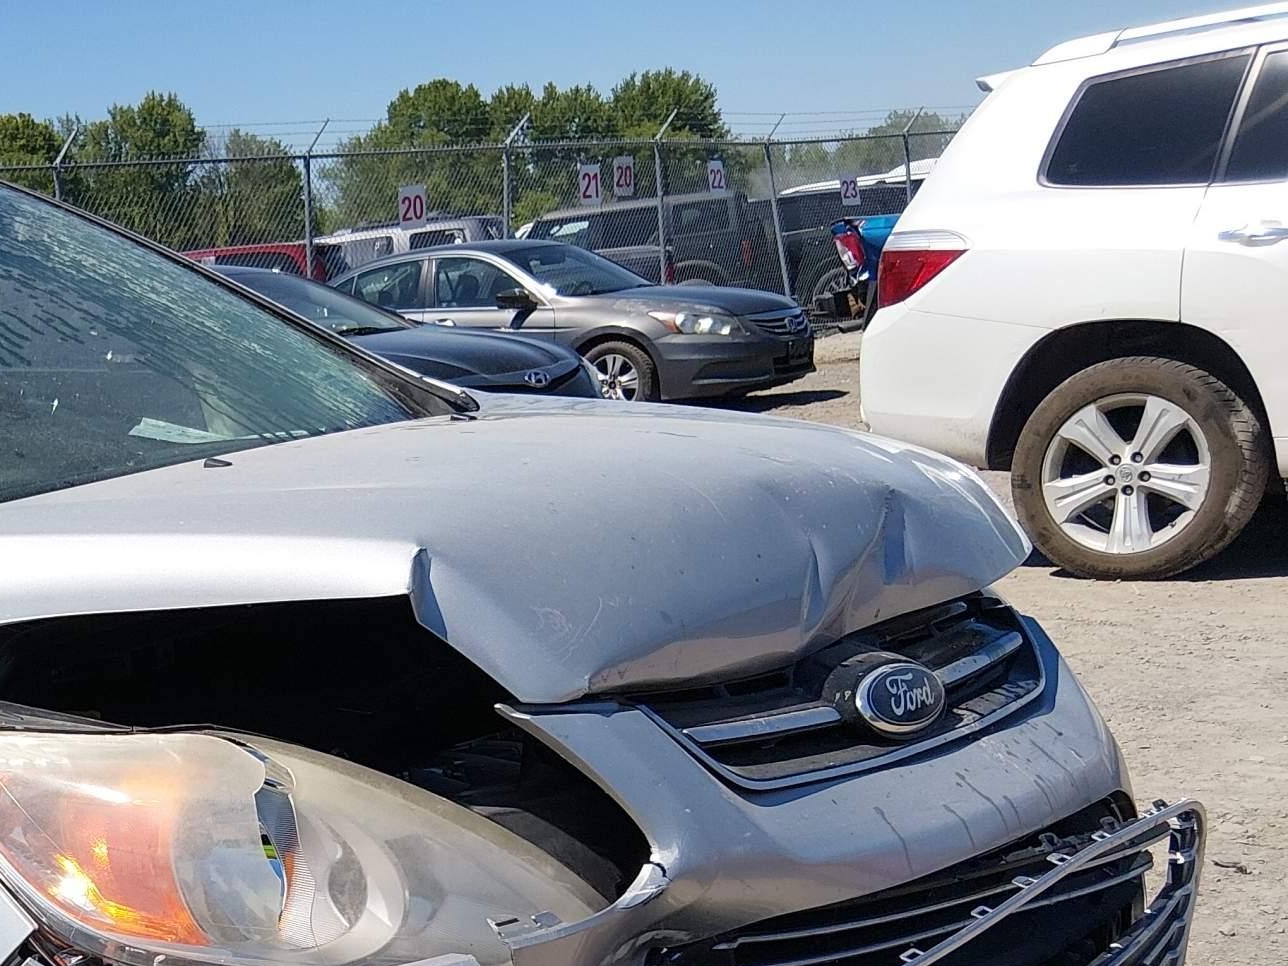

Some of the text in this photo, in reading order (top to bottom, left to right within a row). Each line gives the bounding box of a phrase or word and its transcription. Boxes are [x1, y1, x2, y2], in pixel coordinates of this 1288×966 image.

[582, 171, 601, 199] 21
[616, 165, 633, 187] 20
[709, 169, 725, 190] 22
[840, 179, 858, 200] 23
[400, 194, 425, 222] 20
[886, 673, 935, 716] Ford
